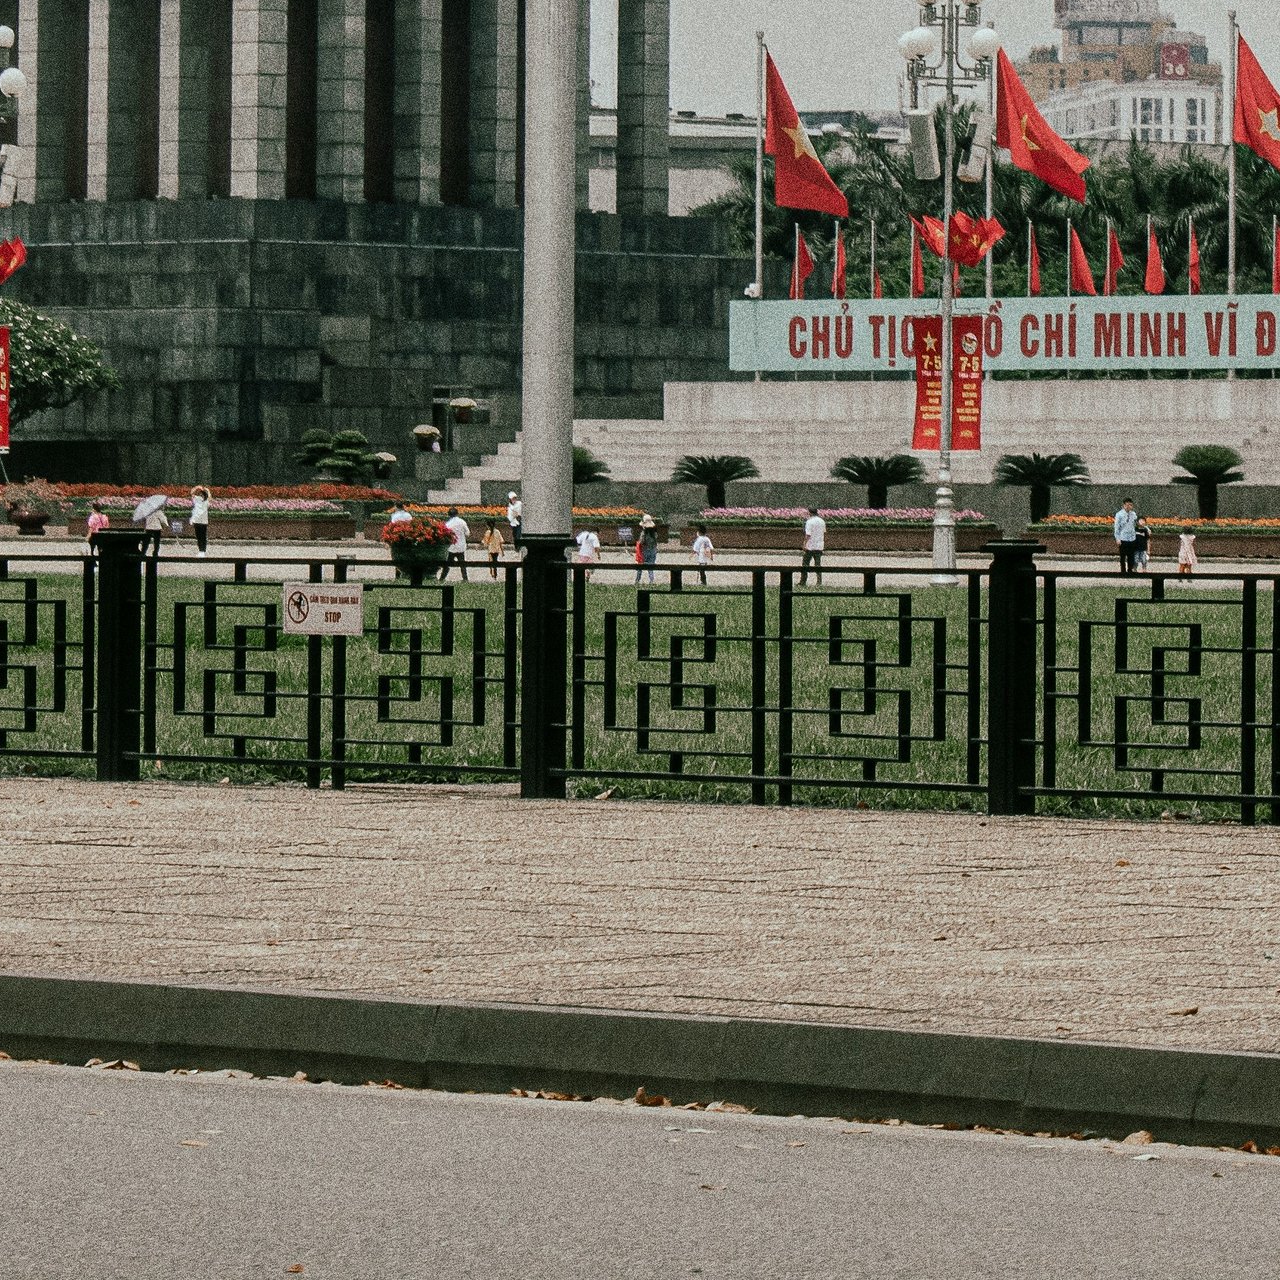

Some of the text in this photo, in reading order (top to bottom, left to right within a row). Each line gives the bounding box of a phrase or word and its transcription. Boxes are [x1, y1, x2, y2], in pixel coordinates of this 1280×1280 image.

[789, 302, 854, 359] CHỦ
[869, 314, 917, 367] TỊC
[984, 300, 1004, 359] Ồ
[1021, 303, 1077, 358] CHÍ
[1095, 312, 1187, 357] MINH
[1205, 302, 1237, 357] VĨ
[324, 611, 342, 623] STOP
